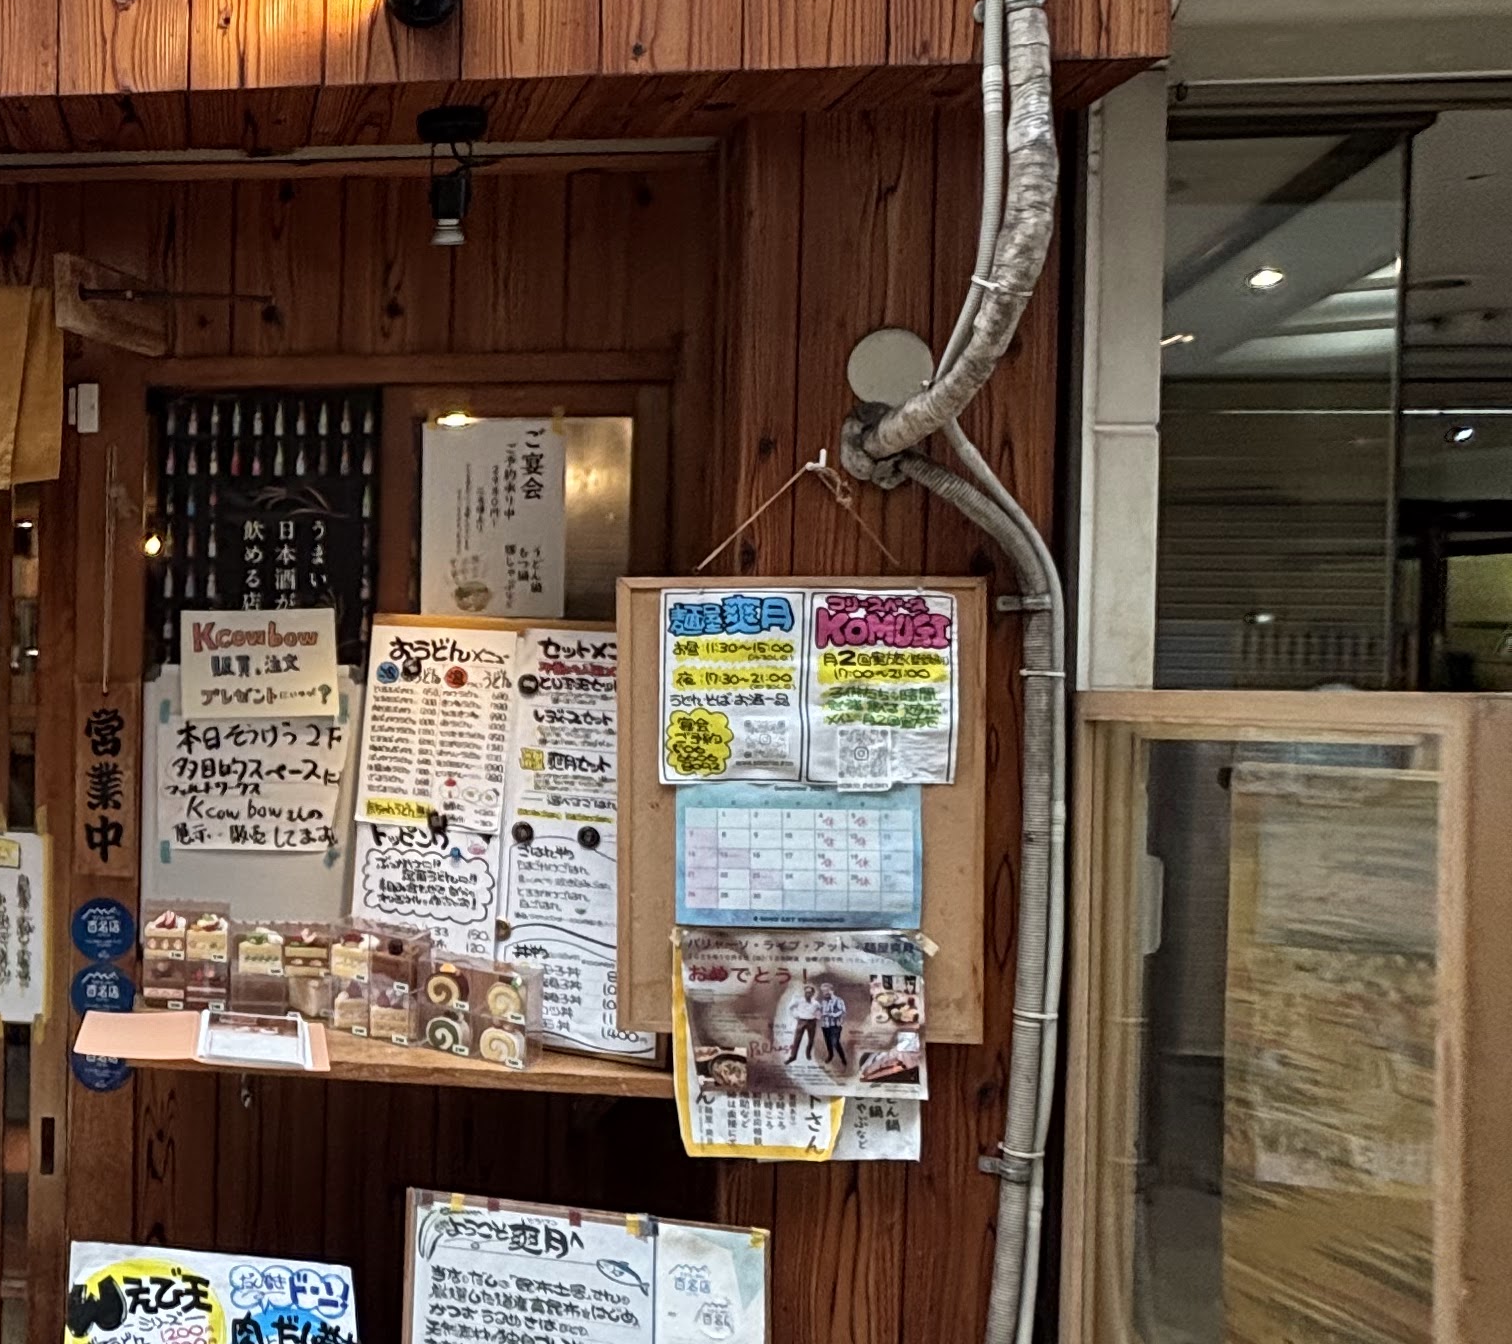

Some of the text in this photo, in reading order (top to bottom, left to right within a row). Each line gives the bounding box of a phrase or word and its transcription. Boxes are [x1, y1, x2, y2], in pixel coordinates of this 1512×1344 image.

[308, 520, 329, 588] うまい
[668, 594, 794, 636] 麺屋爽月
[84, 707, 125, 864] 営業中
